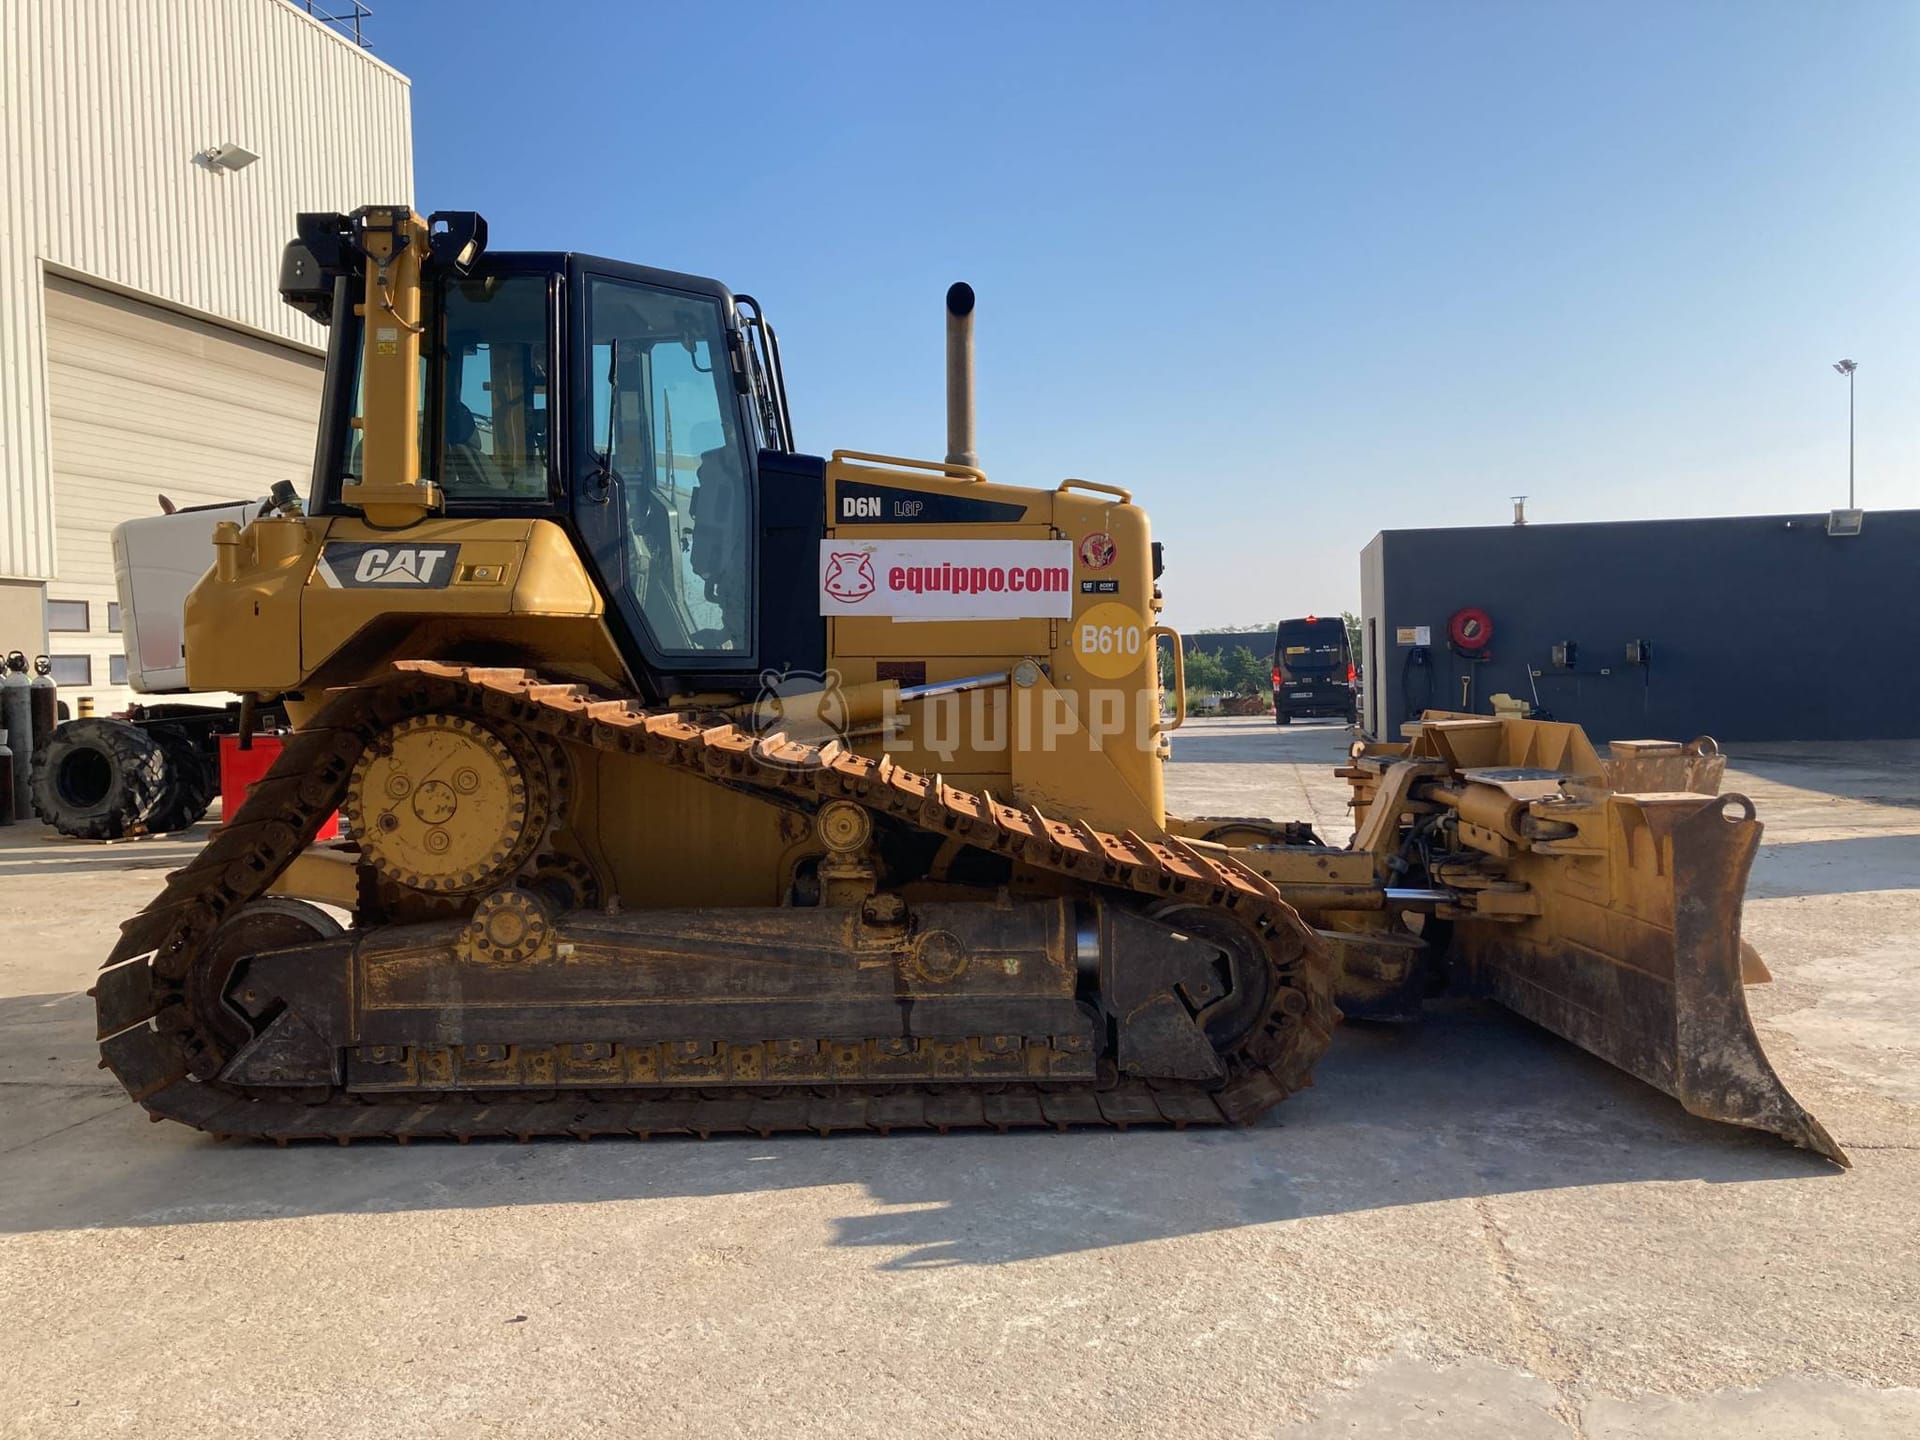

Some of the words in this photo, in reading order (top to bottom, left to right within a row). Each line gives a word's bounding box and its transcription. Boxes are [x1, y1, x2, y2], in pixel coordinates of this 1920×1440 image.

[843, 497, 881, 517] D6N
[894, 501, 923, 517] LGP
[355, 549, 447, 583] CAT
[888, 562, 1069, 593] equippo.com
[1081, 625, 1140, 654] B610
